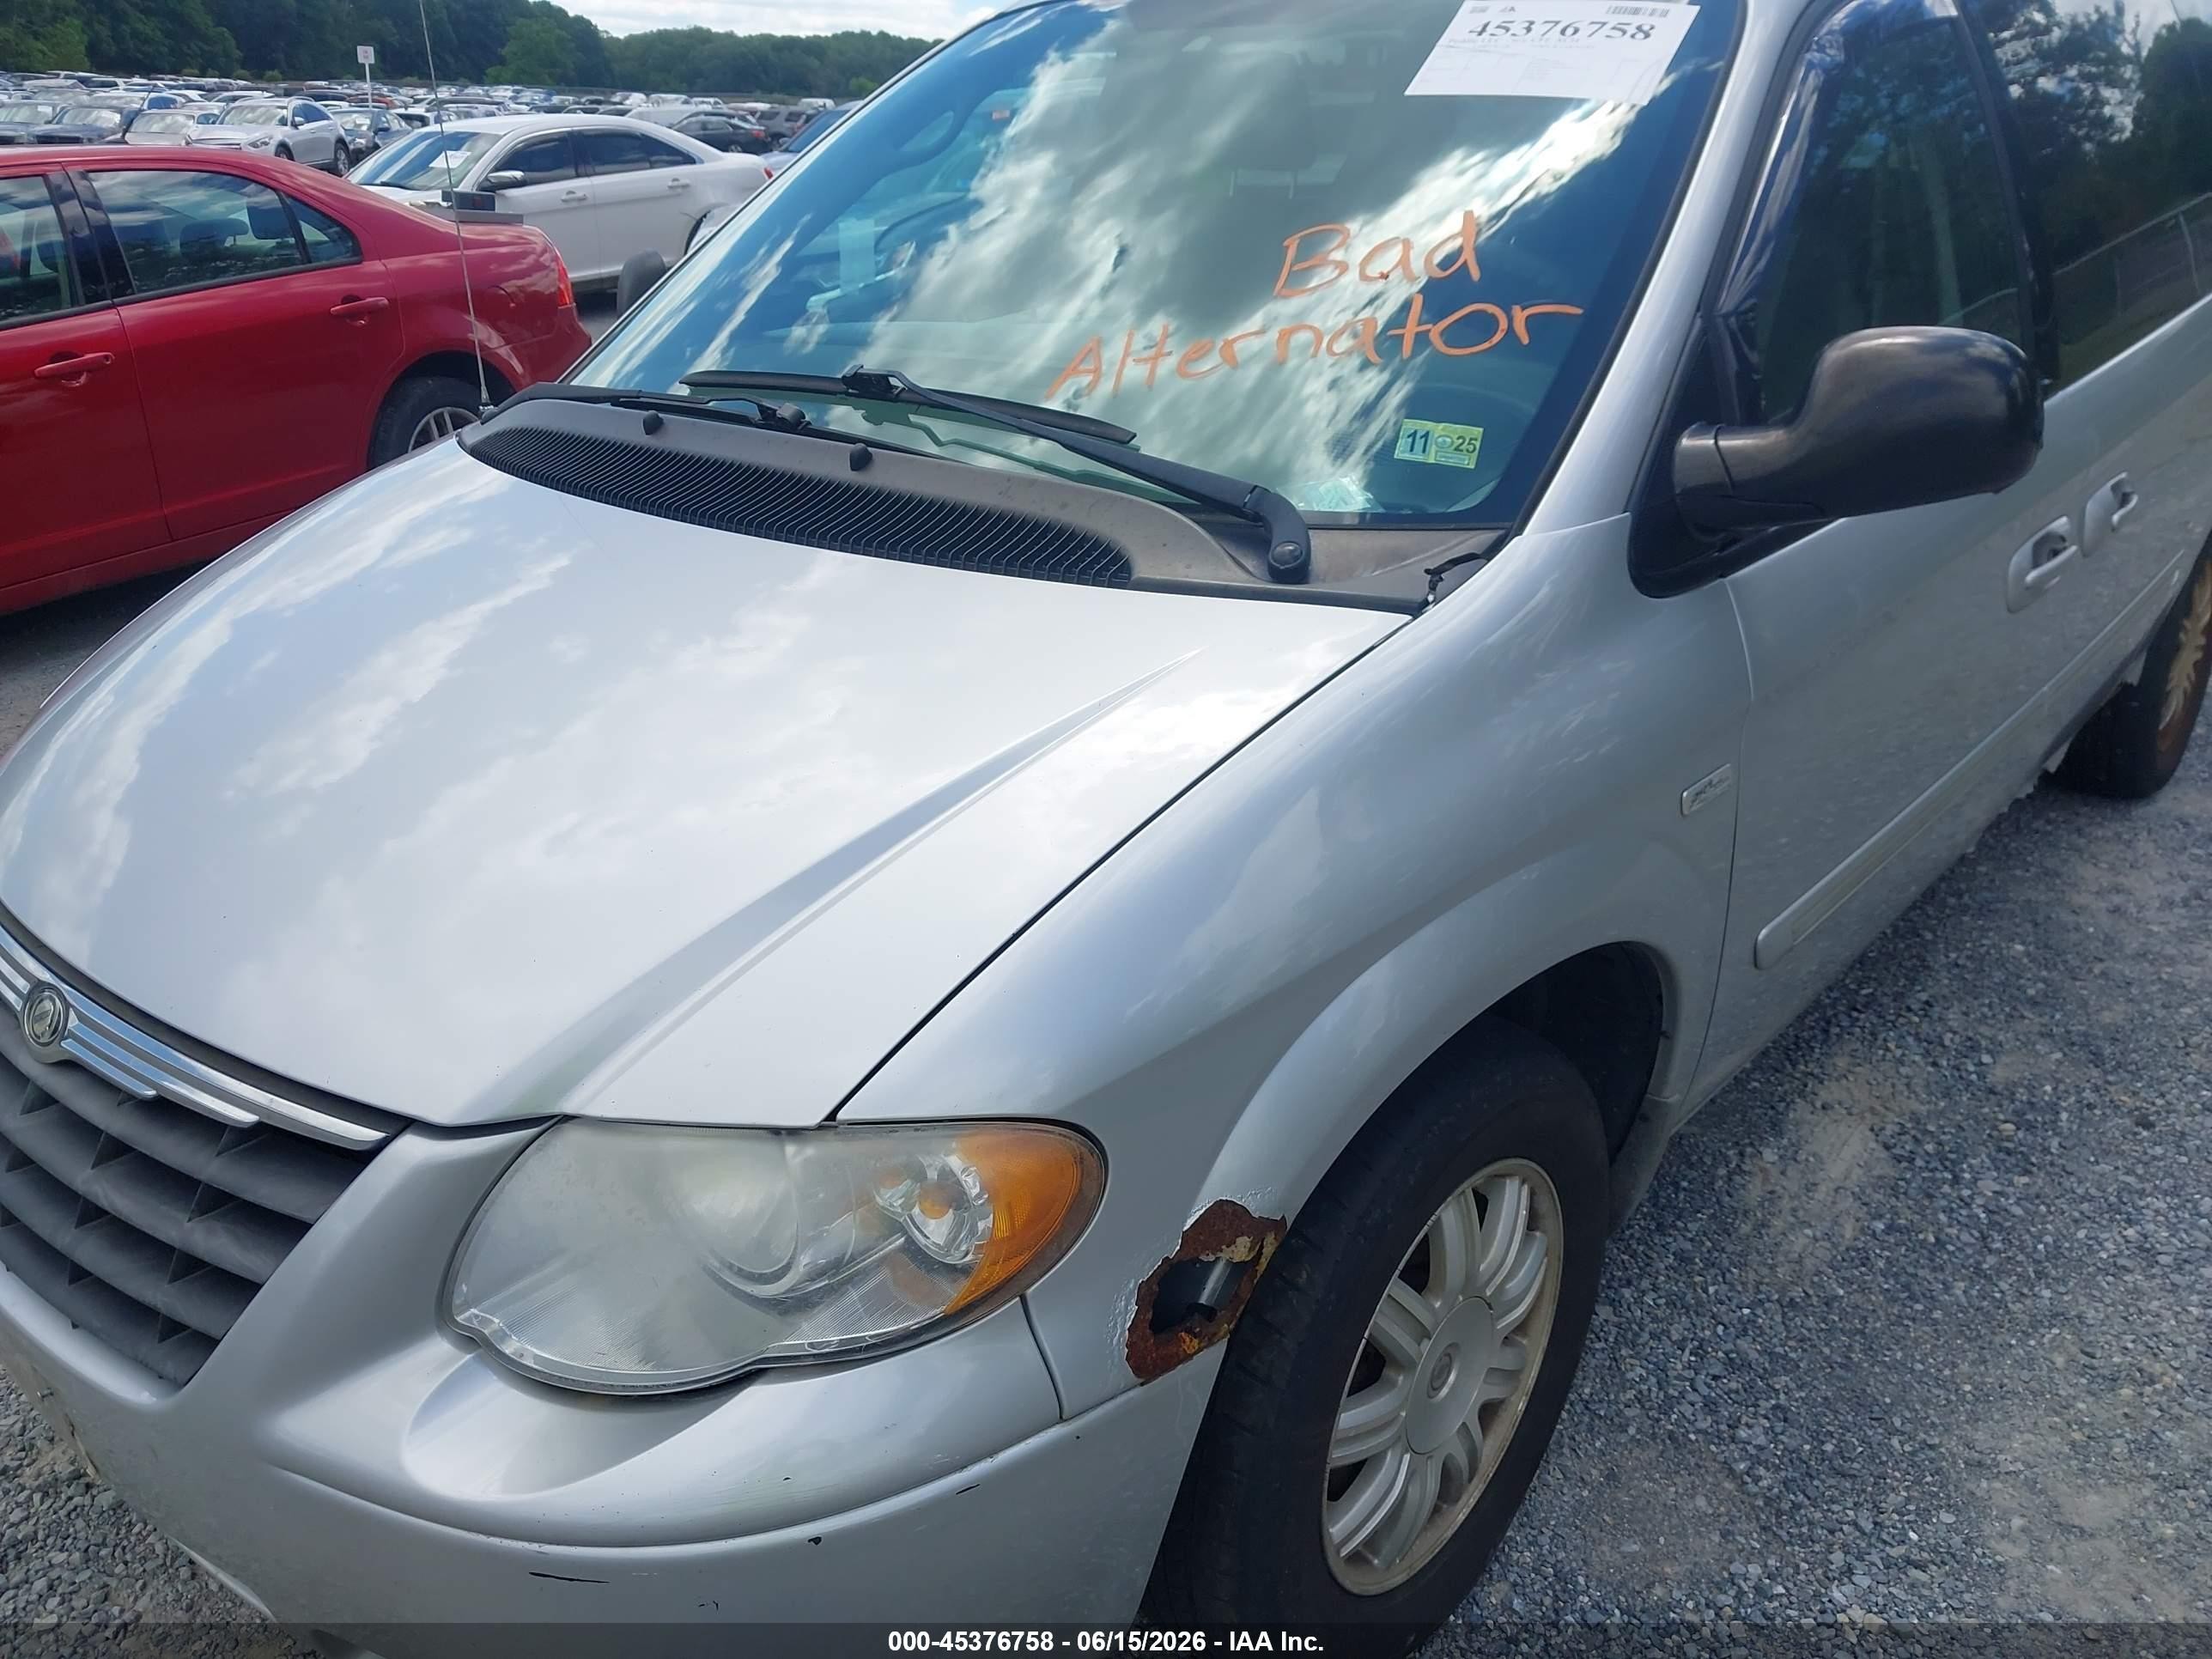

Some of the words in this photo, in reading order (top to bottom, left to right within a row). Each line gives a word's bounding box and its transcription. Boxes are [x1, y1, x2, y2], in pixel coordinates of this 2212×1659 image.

[1468, 20, 1656, 40] 45376758
[1273, 210, 1481, 298] Bad
[1043, 293, 1584, 399] Alternator
[1407, 428, 1430, 453] 11
[1453, 435, 1478, 454] 25
